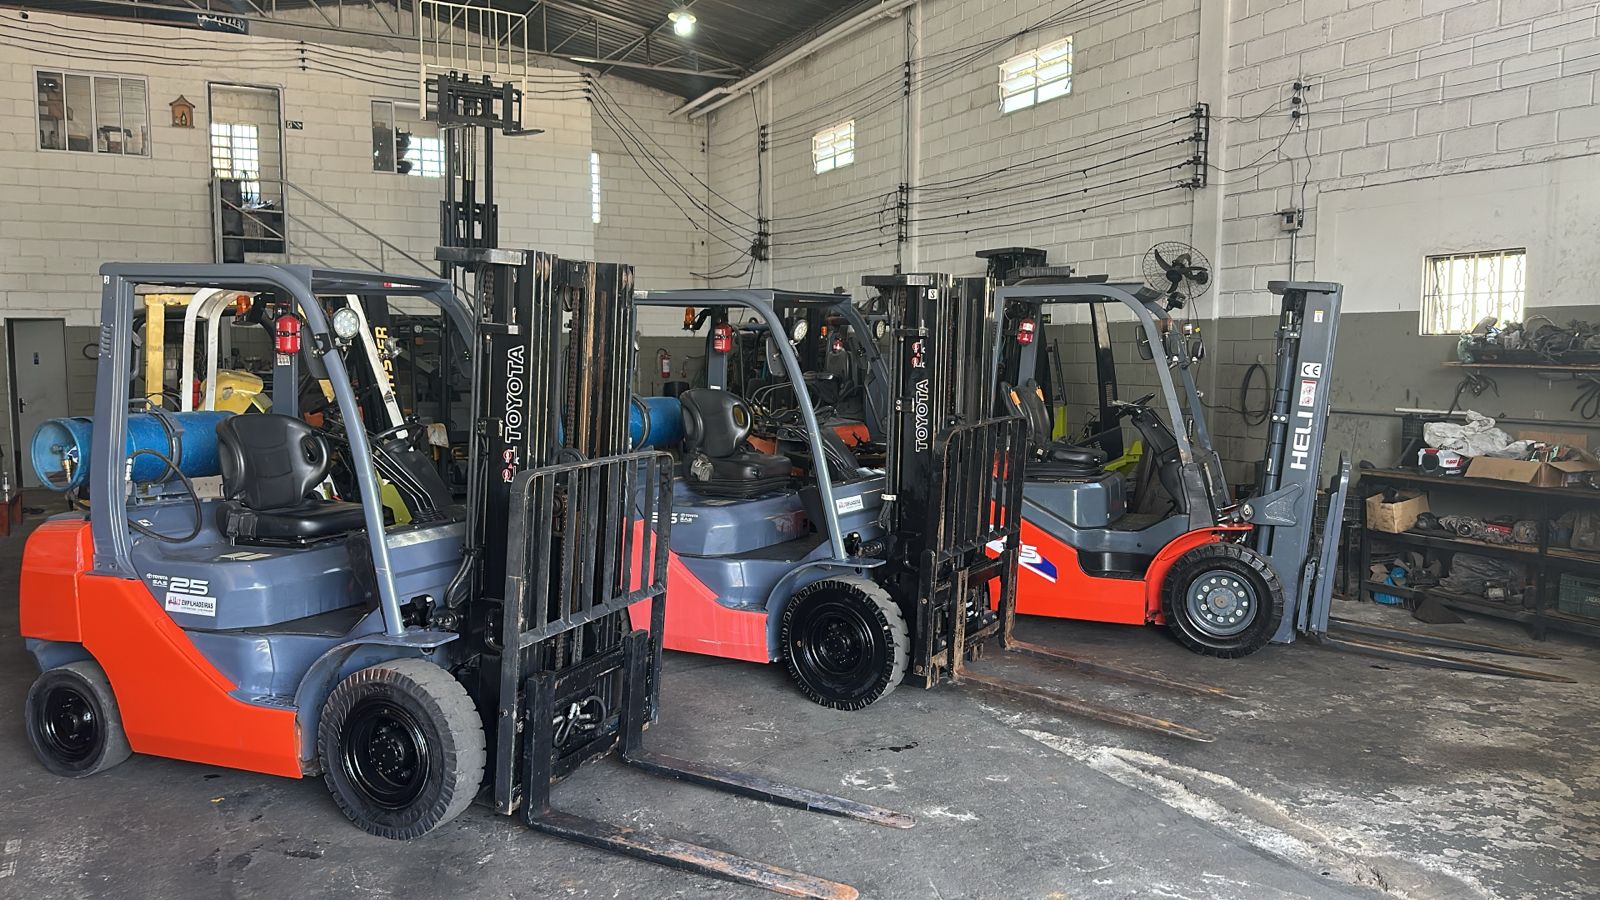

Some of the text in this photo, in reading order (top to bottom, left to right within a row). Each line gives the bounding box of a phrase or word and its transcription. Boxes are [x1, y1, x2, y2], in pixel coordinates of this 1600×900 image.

[375, 326, 397, 396] YSER
[1303, 364, 1321, 375] CE
[505, 345, 524, 443] TOYOTA
[915, 378, 929, 452] TOYOTA
[1290, 411, 1314, 470] HELI
[169, 577, 209, 596] 25
[181, 599, 214, 609] EMPILHADEIRAS
